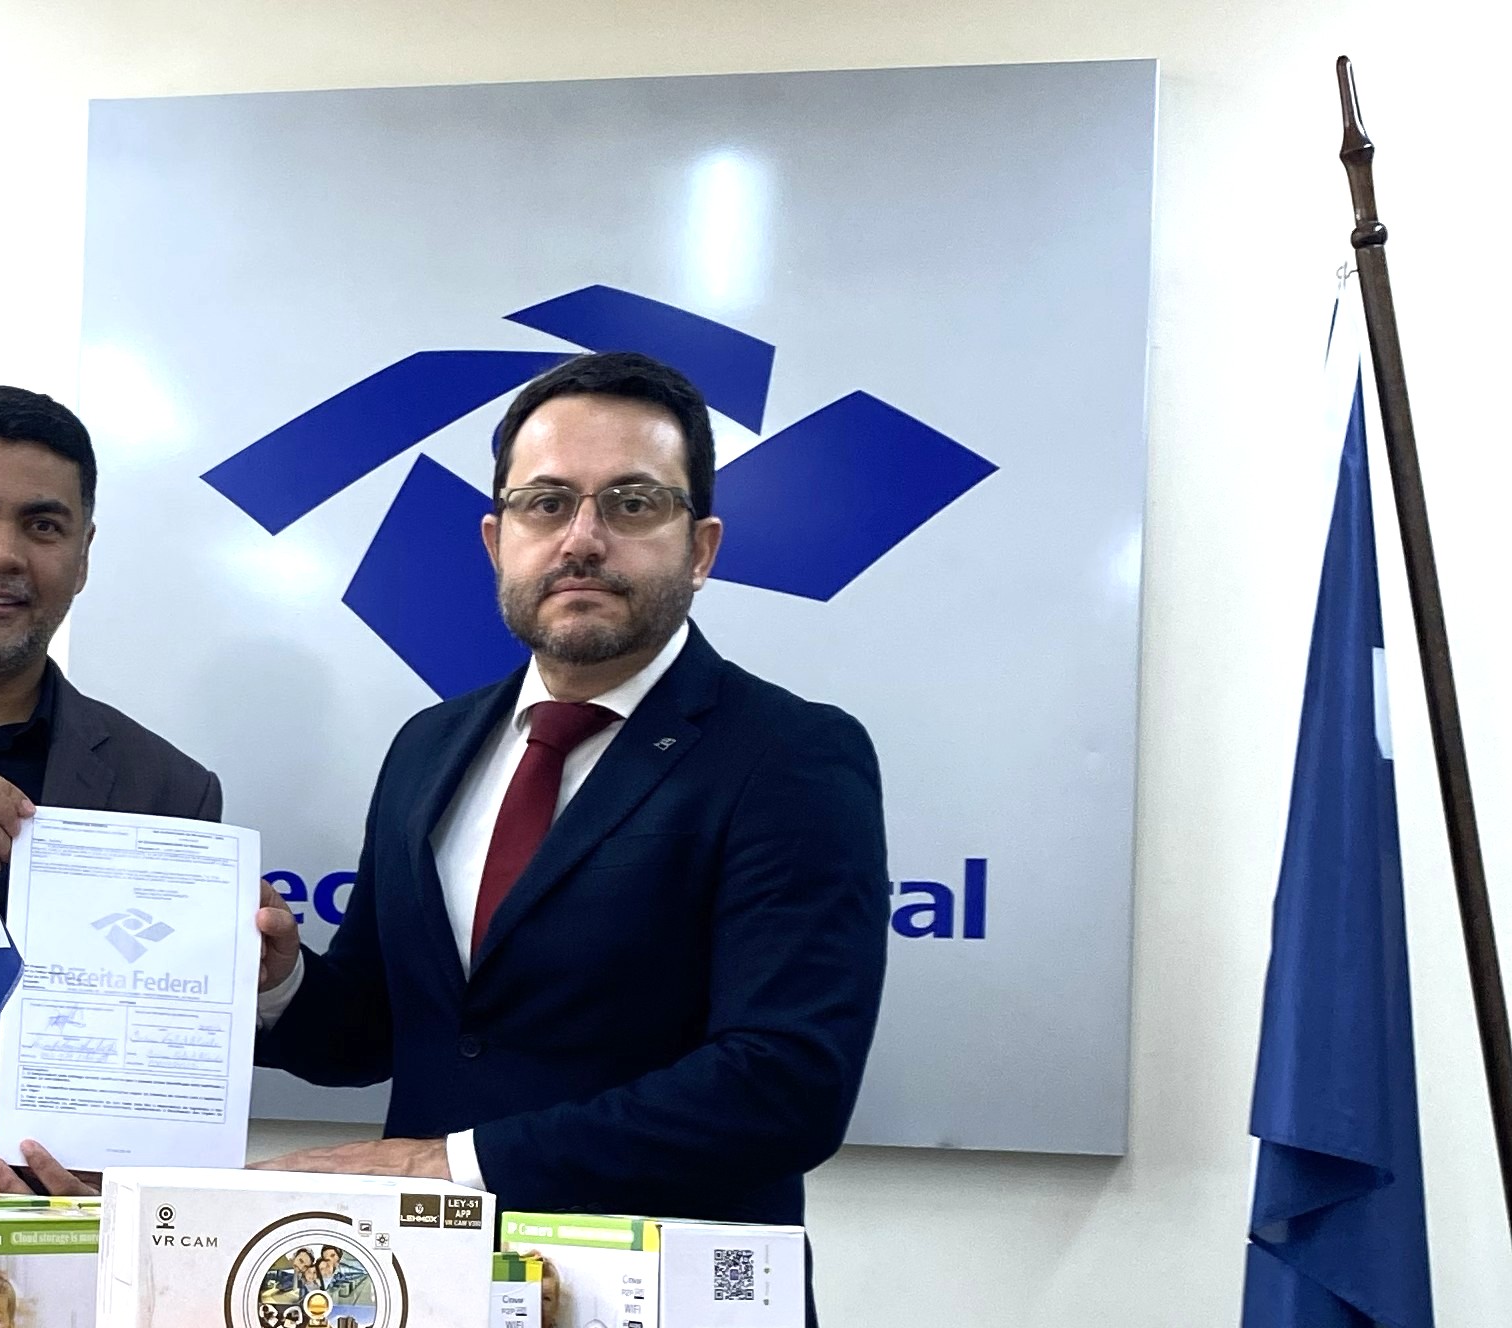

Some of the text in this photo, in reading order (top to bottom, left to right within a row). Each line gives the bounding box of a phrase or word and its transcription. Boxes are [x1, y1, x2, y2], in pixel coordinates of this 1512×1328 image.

[49, 964, 127, 989] Receita
[133, 970, 209, 995] Federal
[448, 1199, 478, 1208] LEY-51
[12, 1232, 38, 1243] Cloud
[151, 1234, 218, 1248] VR CAM
